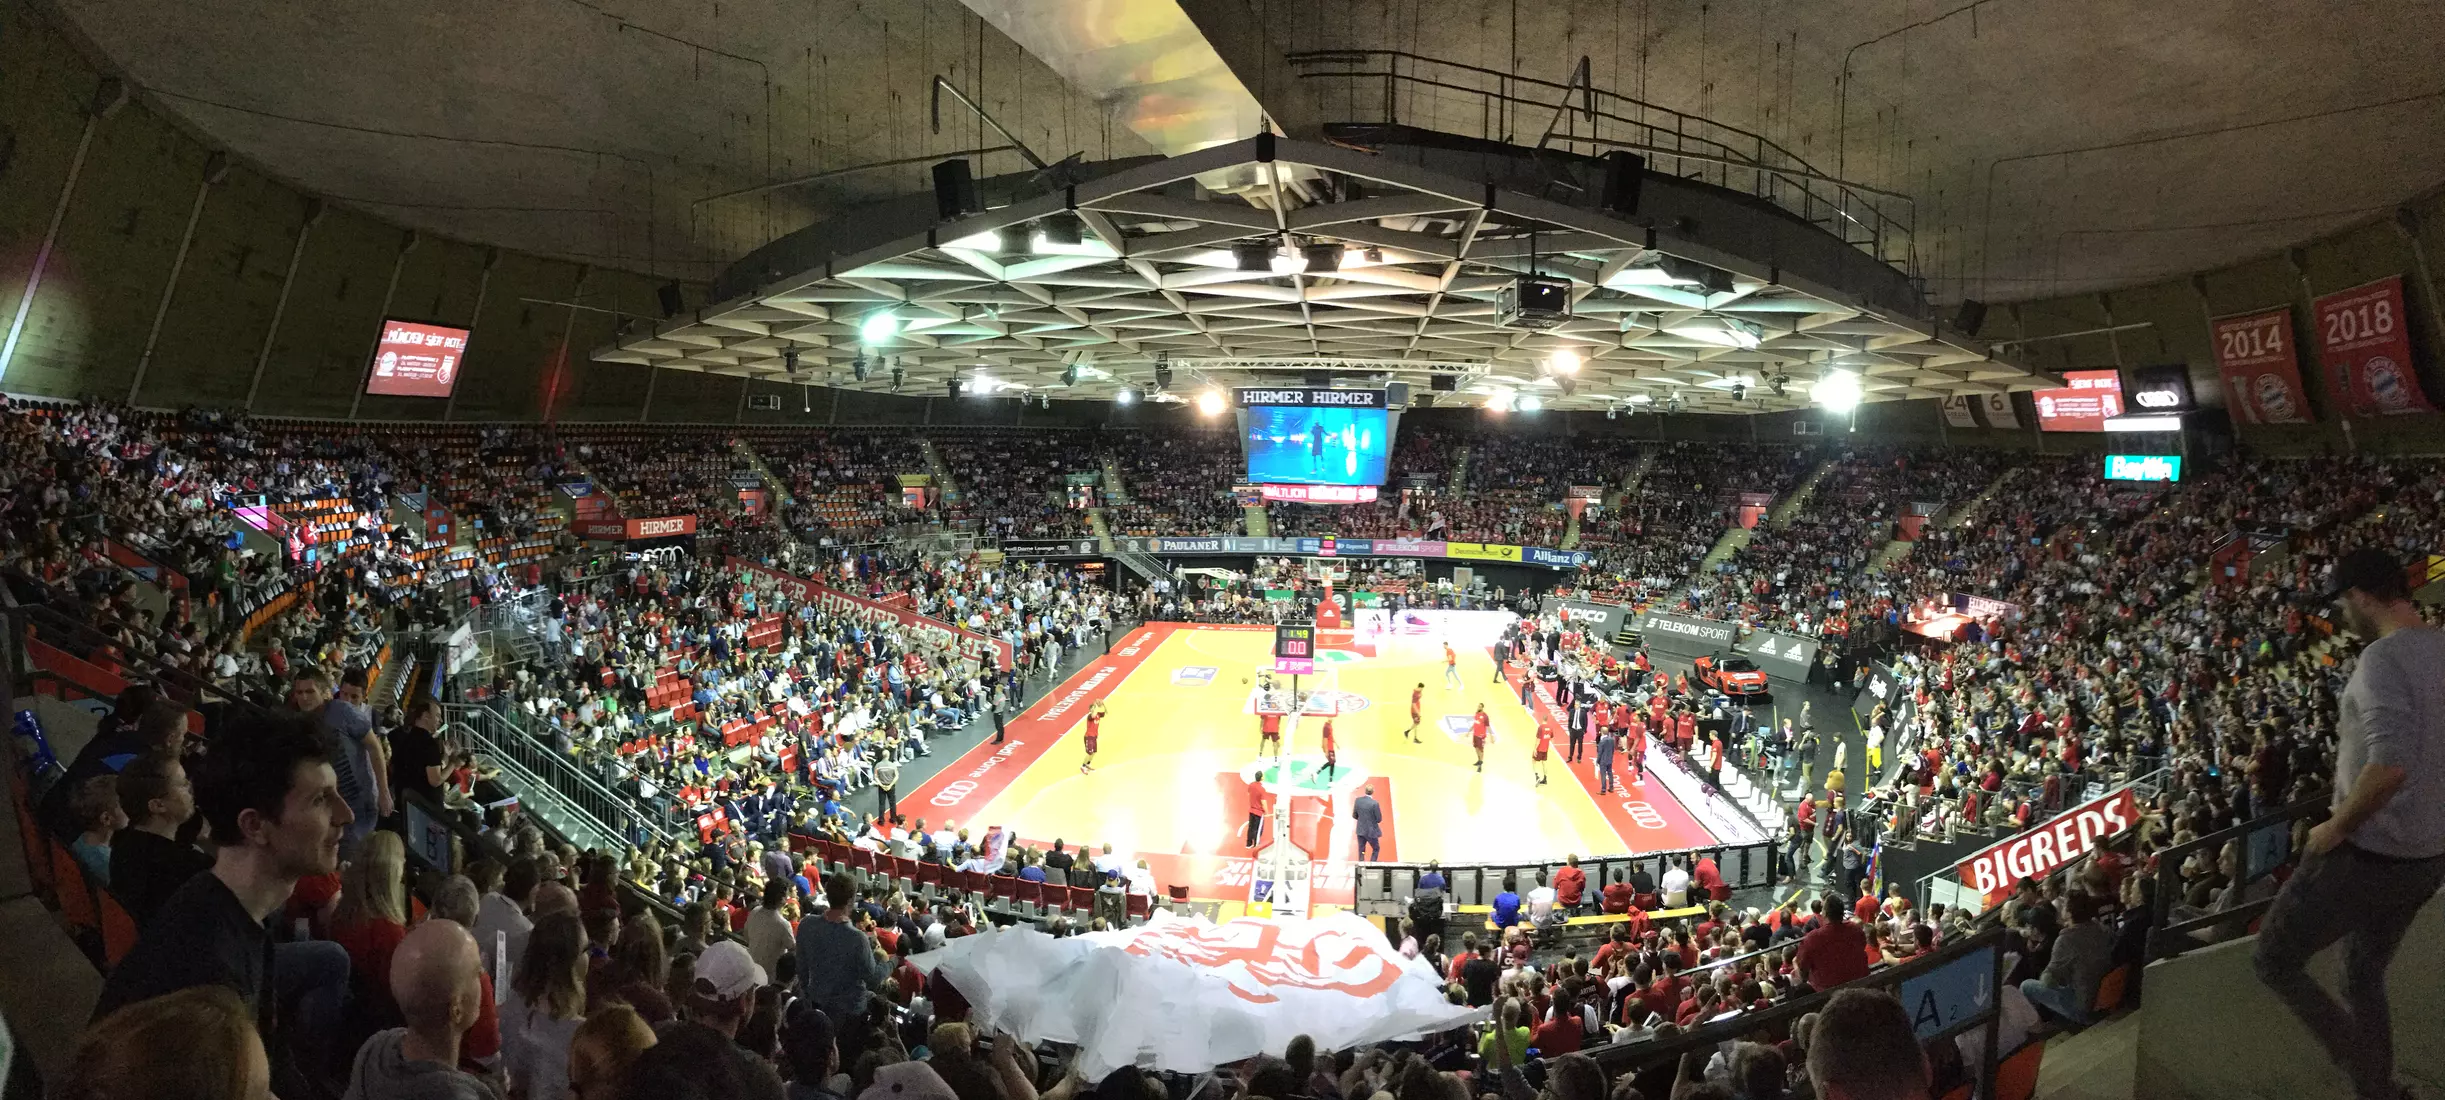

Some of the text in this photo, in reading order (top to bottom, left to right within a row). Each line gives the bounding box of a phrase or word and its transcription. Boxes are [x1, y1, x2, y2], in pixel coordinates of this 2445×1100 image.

[2325, 300, 2394, 345] 2018
[2221, 324, 2284, 360] 2014
[1243, 391, 1374, 405] HIRMER HIRMER
[1990, 393, 2004, 411] 6
[1573, 487, 1602, 497] tipico
[588, 525, 623, 535] HIRMER
[640, 519, 684, 535] HIRMER
[1163, 540, 1219, 551] PAULANER
[1385, 543, 1443, 552] TELEKOM SPORT
[1533, 550, 1570, 564] Allianz
[1659, 619, 1731, 641] TELEKOM SPORT
[968, 739, 1025, 778] Audi Dome
[1973, 797, 2128, 895] BIGREDS
[1913, 989, 1958, 1033] A 2
